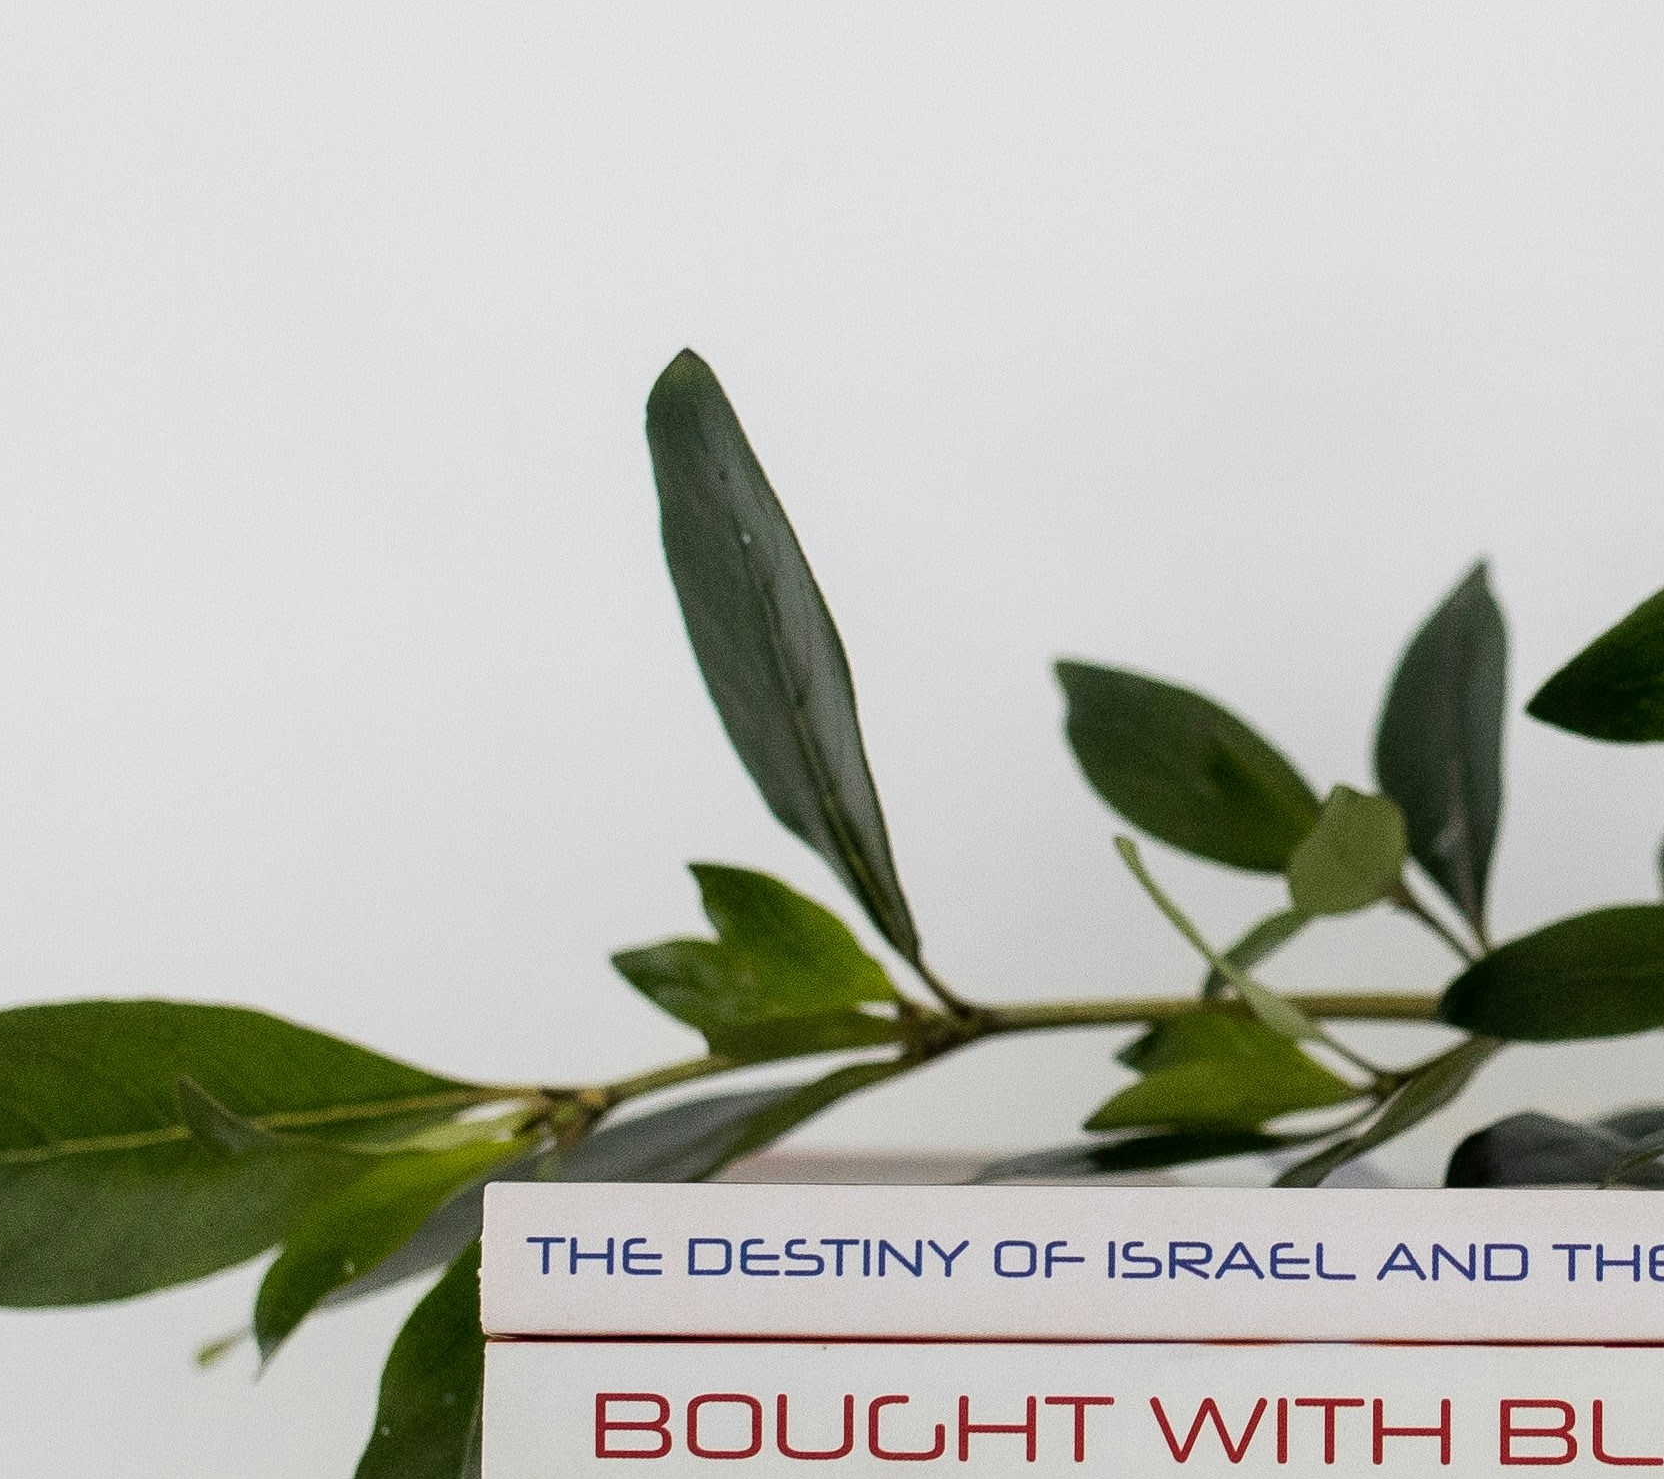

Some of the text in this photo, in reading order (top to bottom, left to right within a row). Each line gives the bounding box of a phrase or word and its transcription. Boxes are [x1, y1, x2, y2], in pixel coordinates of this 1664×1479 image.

[525, 1236, 664, 1277] THE
[686, 1237, 970, 1279] DESTINY
[993, 1239, 1086, 1280] OF
[1106, 1240, 1357, 1282] ISRAEL
[1375, 1242, 1530, 1283] AND
[594, 1391, 1116, 1464] BOUGHT
[1148, 1396, 1452, 1467] WITH
